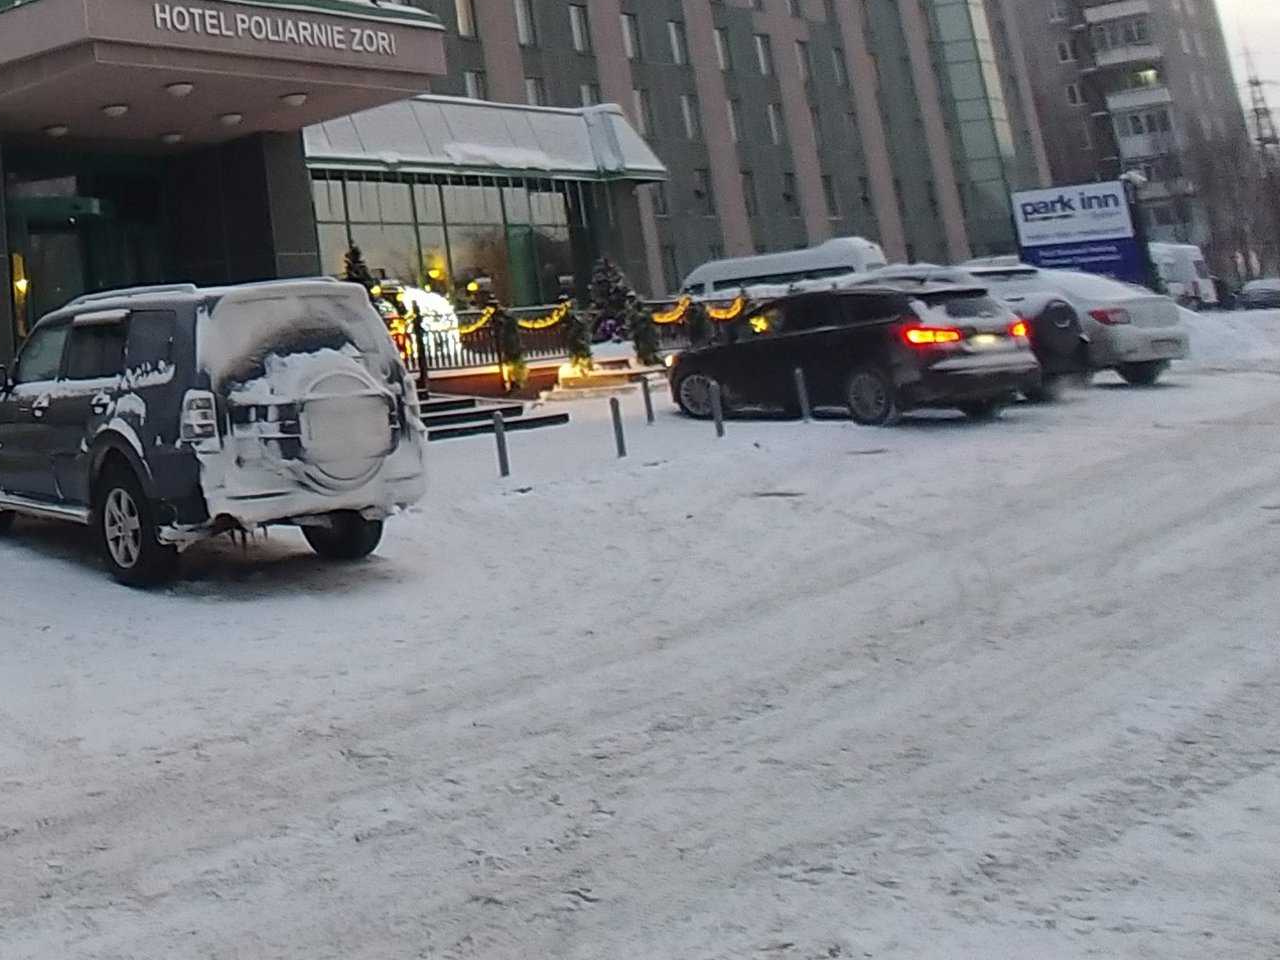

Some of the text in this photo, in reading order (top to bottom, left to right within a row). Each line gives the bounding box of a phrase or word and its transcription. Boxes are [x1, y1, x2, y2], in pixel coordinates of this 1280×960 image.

[153, 2, 397, 56] HOTEL POLIARNIE ZORI
[1021, 194, 1076, 223] park
[1078, 192, 1120, 211] inn
